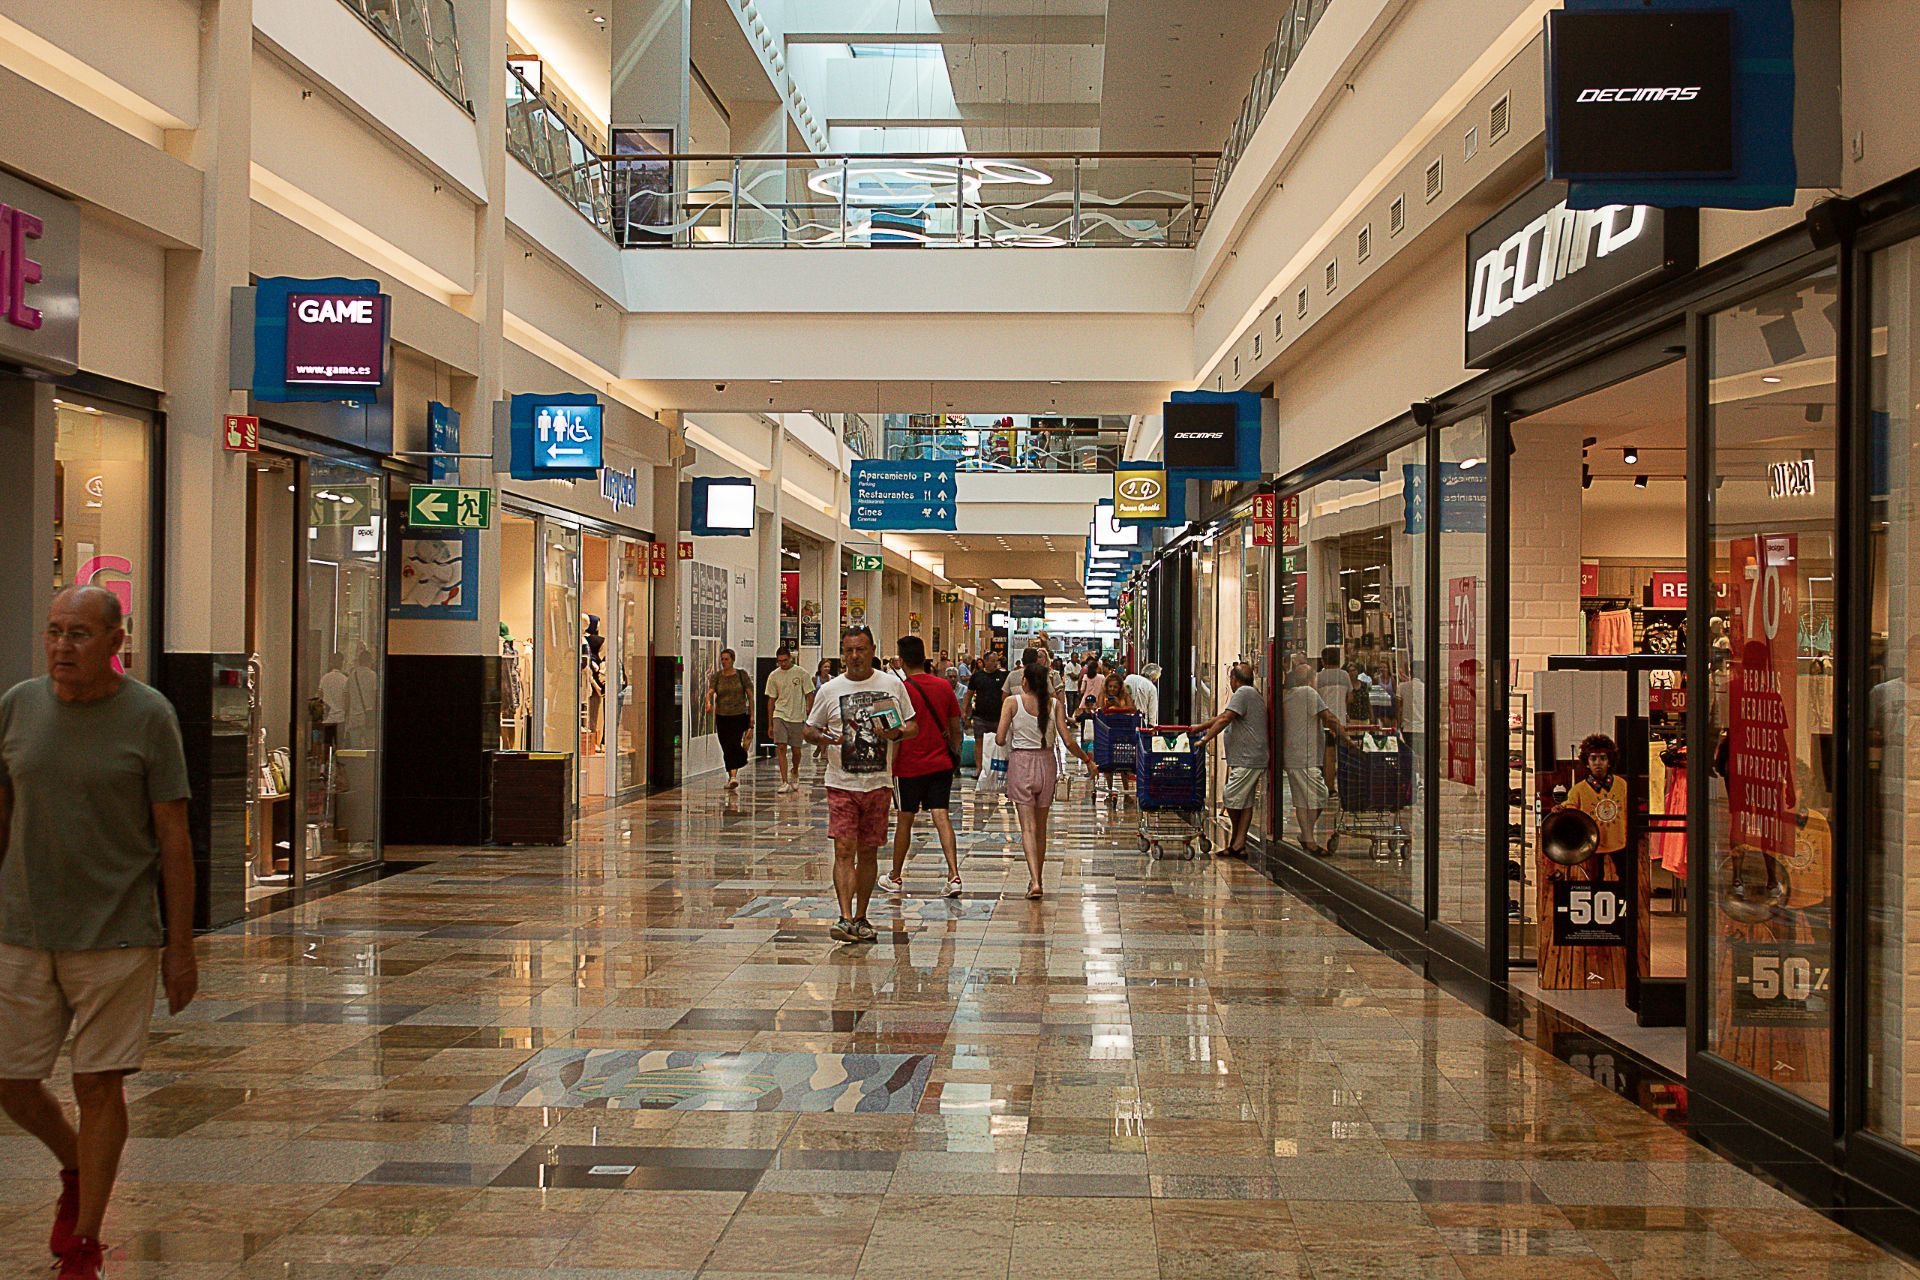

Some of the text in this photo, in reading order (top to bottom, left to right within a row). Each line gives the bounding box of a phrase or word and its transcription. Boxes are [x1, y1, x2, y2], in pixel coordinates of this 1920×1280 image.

[1576, 86, 1701, 103] DECIMAS
[298, 299, 373, 323] GAME
[296, 366, 371, 376] www.game.es
[859, 469, 917, 481] Aparcamiento
[859, 489, 914, 499] Restaurantes
[858, 507, 882, 516] Cines
[1743, 669, 1781, 694] REBAJAS
[1741, 697, 1784, 724] REBAIXES
[1746, 726, 1778, 752] SOLDES
[1745, 783, 1778, 811] SALDOS
